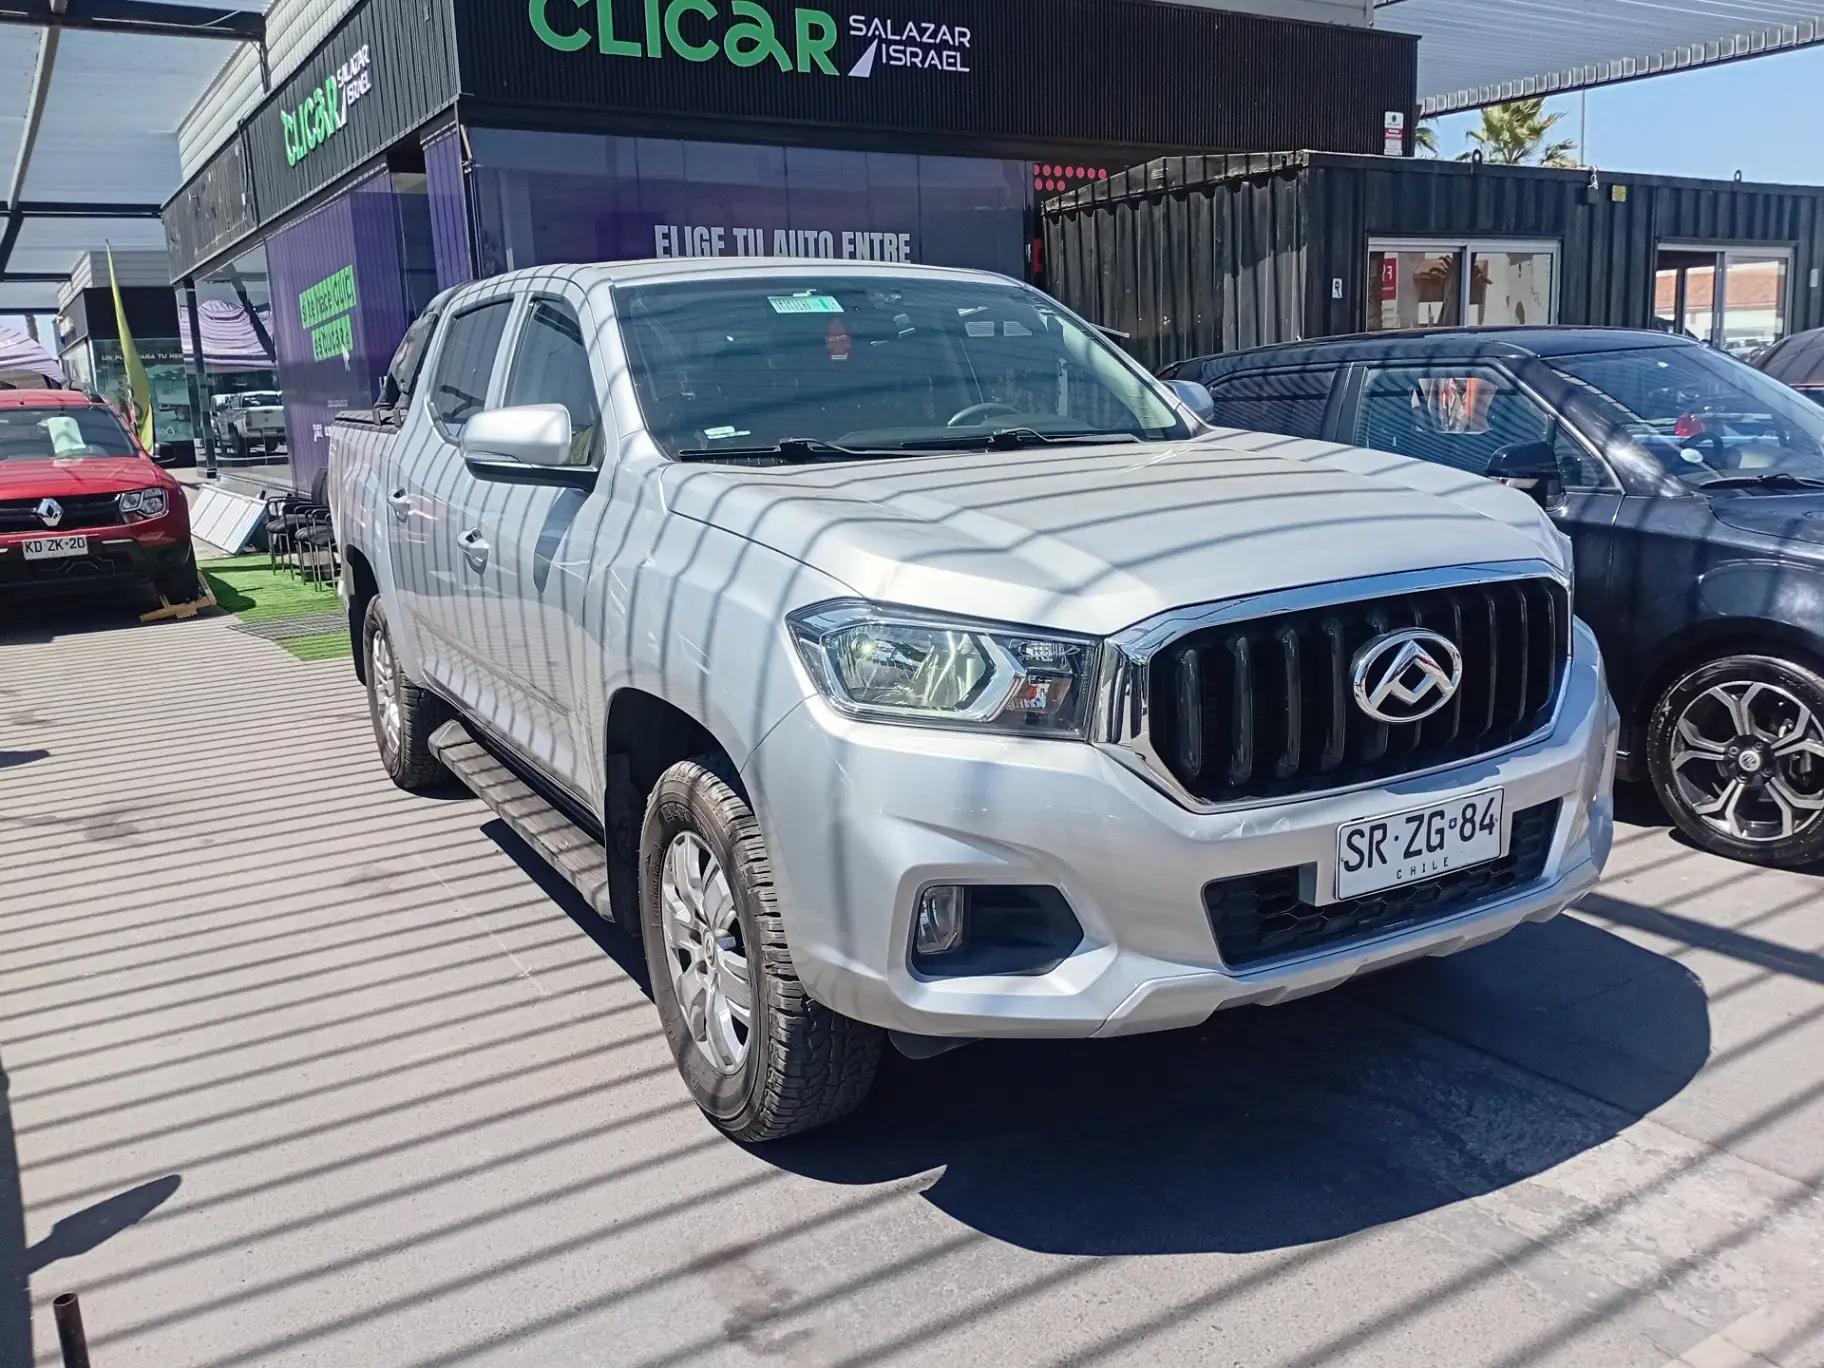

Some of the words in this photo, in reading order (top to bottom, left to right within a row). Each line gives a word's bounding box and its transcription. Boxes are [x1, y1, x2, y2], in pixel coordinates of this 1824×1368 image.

[849, 14, 971, 48] SALAZAR
[882, 43, 970, 72] ISRAEL
[654, 225, 725, 258] ELIGE
[733, 227, 765, 257] TU
[773, 229, 834, 259] AUTO
[842, 231, 911, 264] ENTRE
[1396, 857, 1449, 880] CHILE
